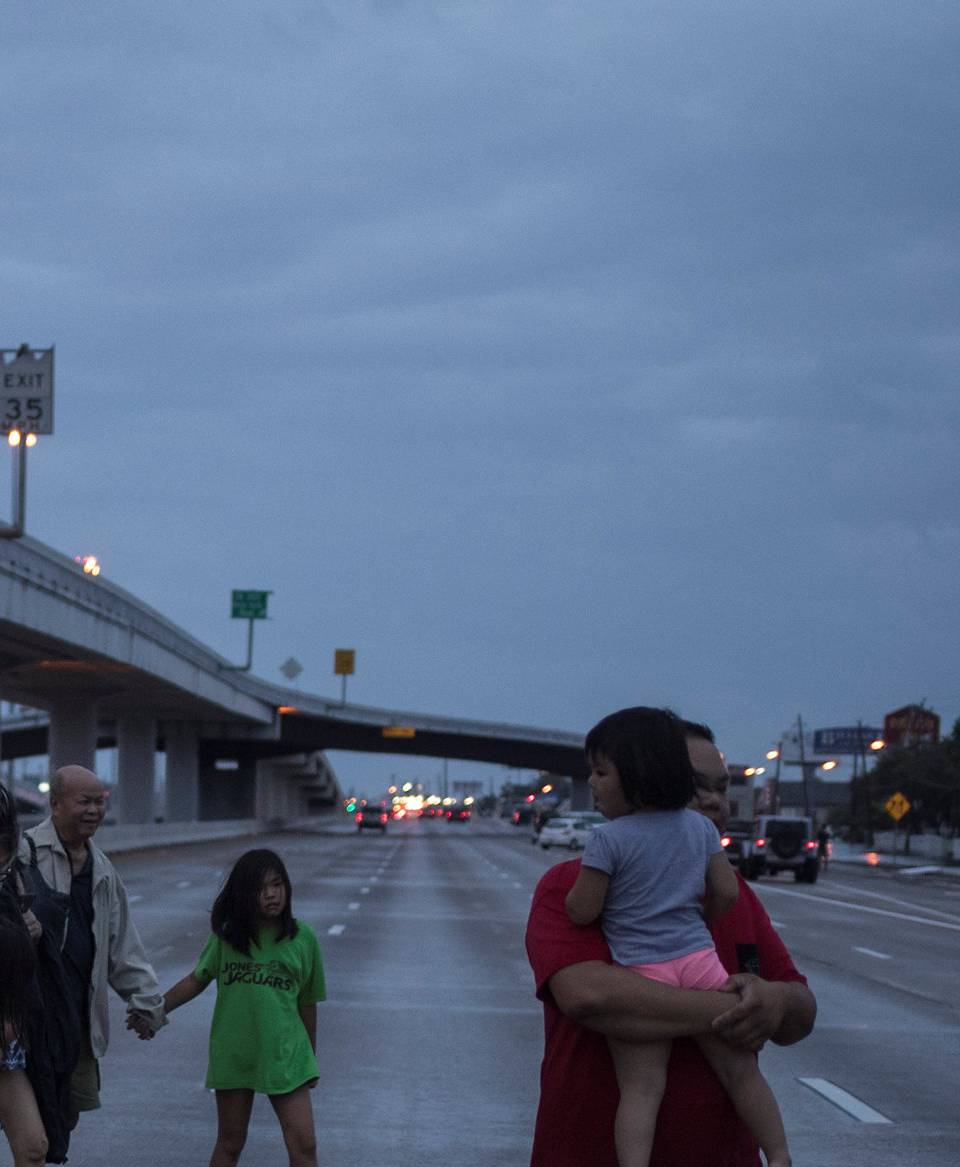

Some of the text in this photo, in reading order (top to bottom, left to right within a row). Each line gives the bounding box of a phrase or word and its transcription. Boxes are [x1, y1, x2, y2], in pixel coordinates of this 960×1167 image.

[4, 373, 44, 388] EXIT
[6, 398, 43, 420] 35
[221, 960, 261, 973] JONES
[223, 971, 292, 991] JAGUARS
